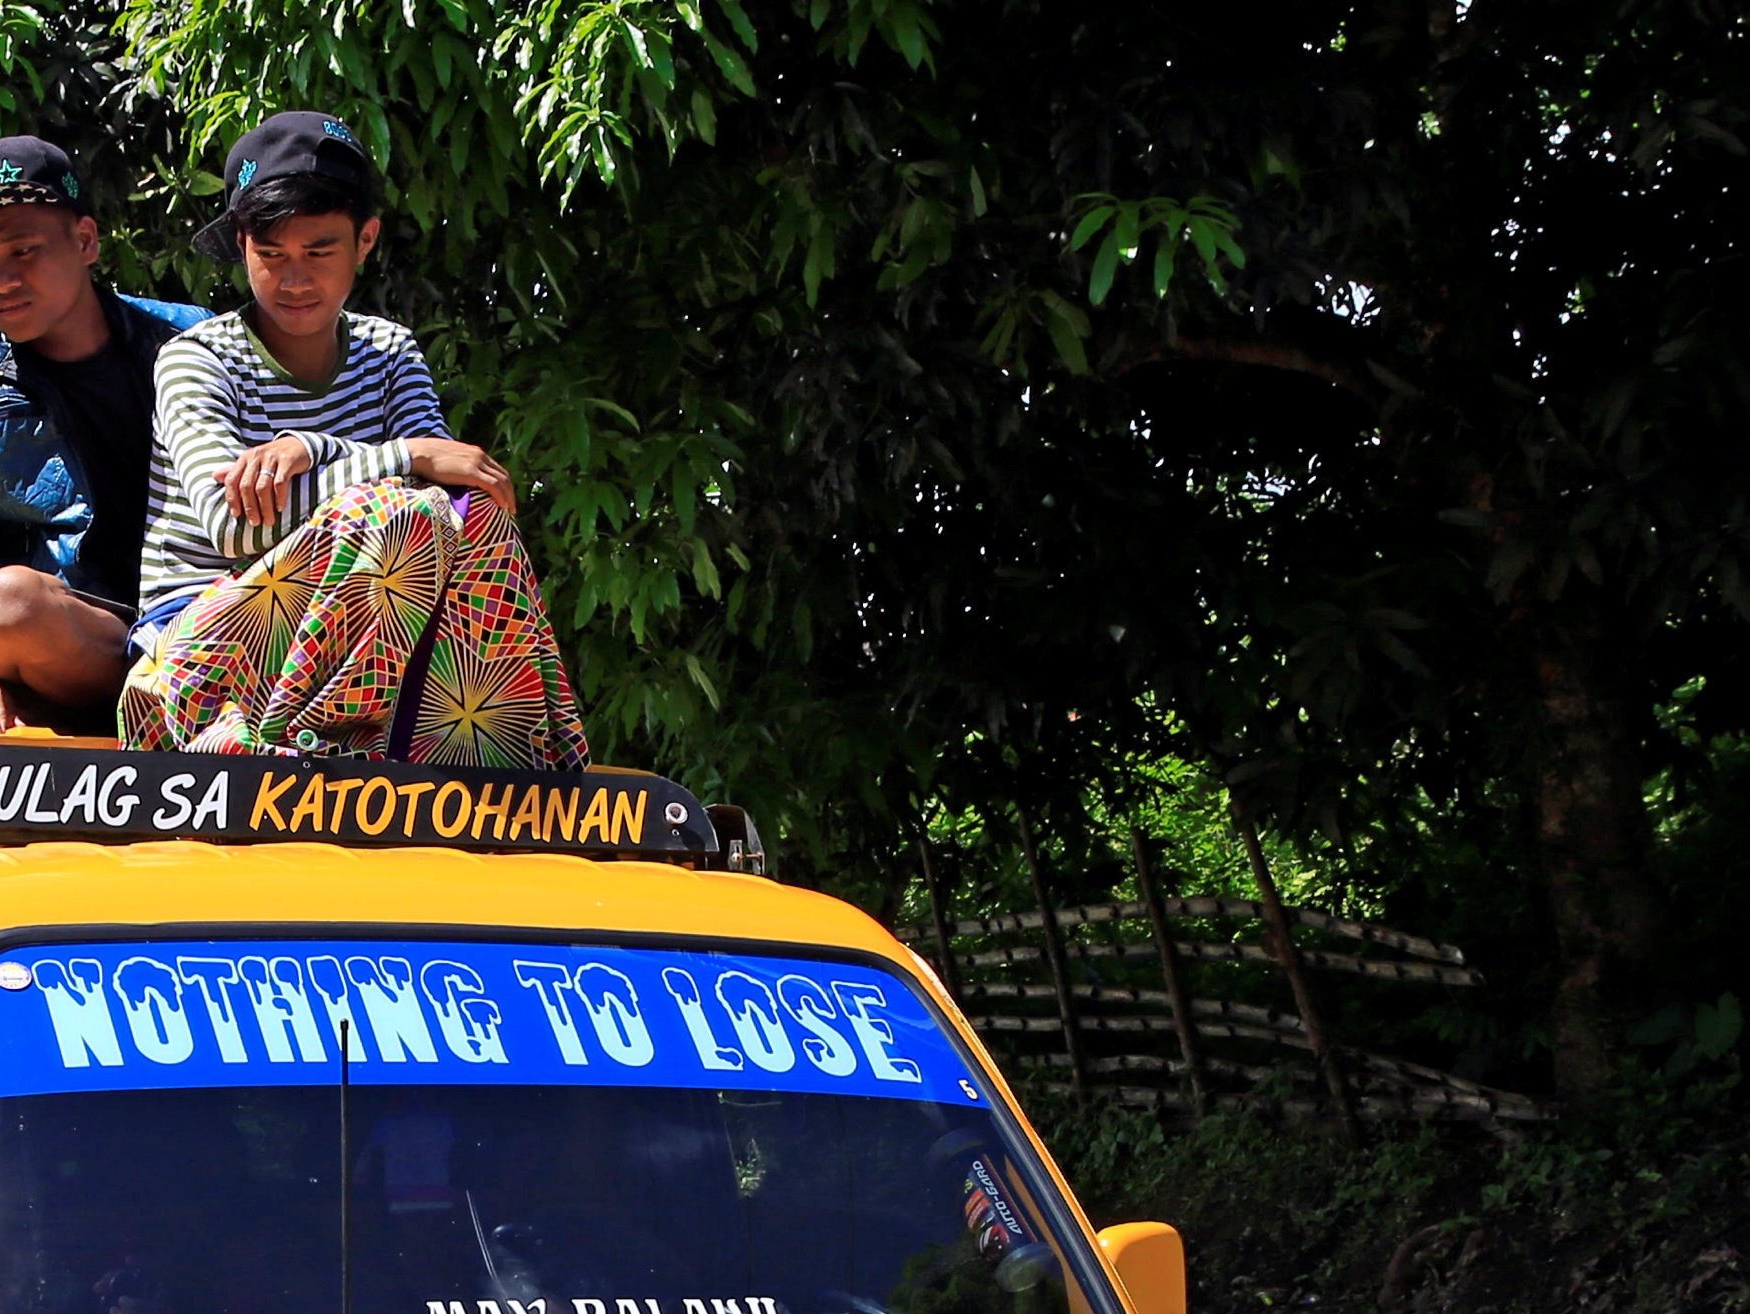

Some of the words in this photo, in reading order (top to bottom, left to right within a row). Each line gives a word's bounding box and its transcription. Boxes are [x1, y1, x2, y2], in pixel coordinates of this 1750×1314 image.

[150, 770, 232, 832] SA
[247, 770, 650, 846] KATOTOHANAN
[33, 953, 510, 1071] NOTHING
[513, 960, 652, 1071] TO
[661, 966, 924, 1086] LOSE
[958, 1079, 979, 1101] 5
[972, 1160, 1023, 1235] AUTO-GARD
